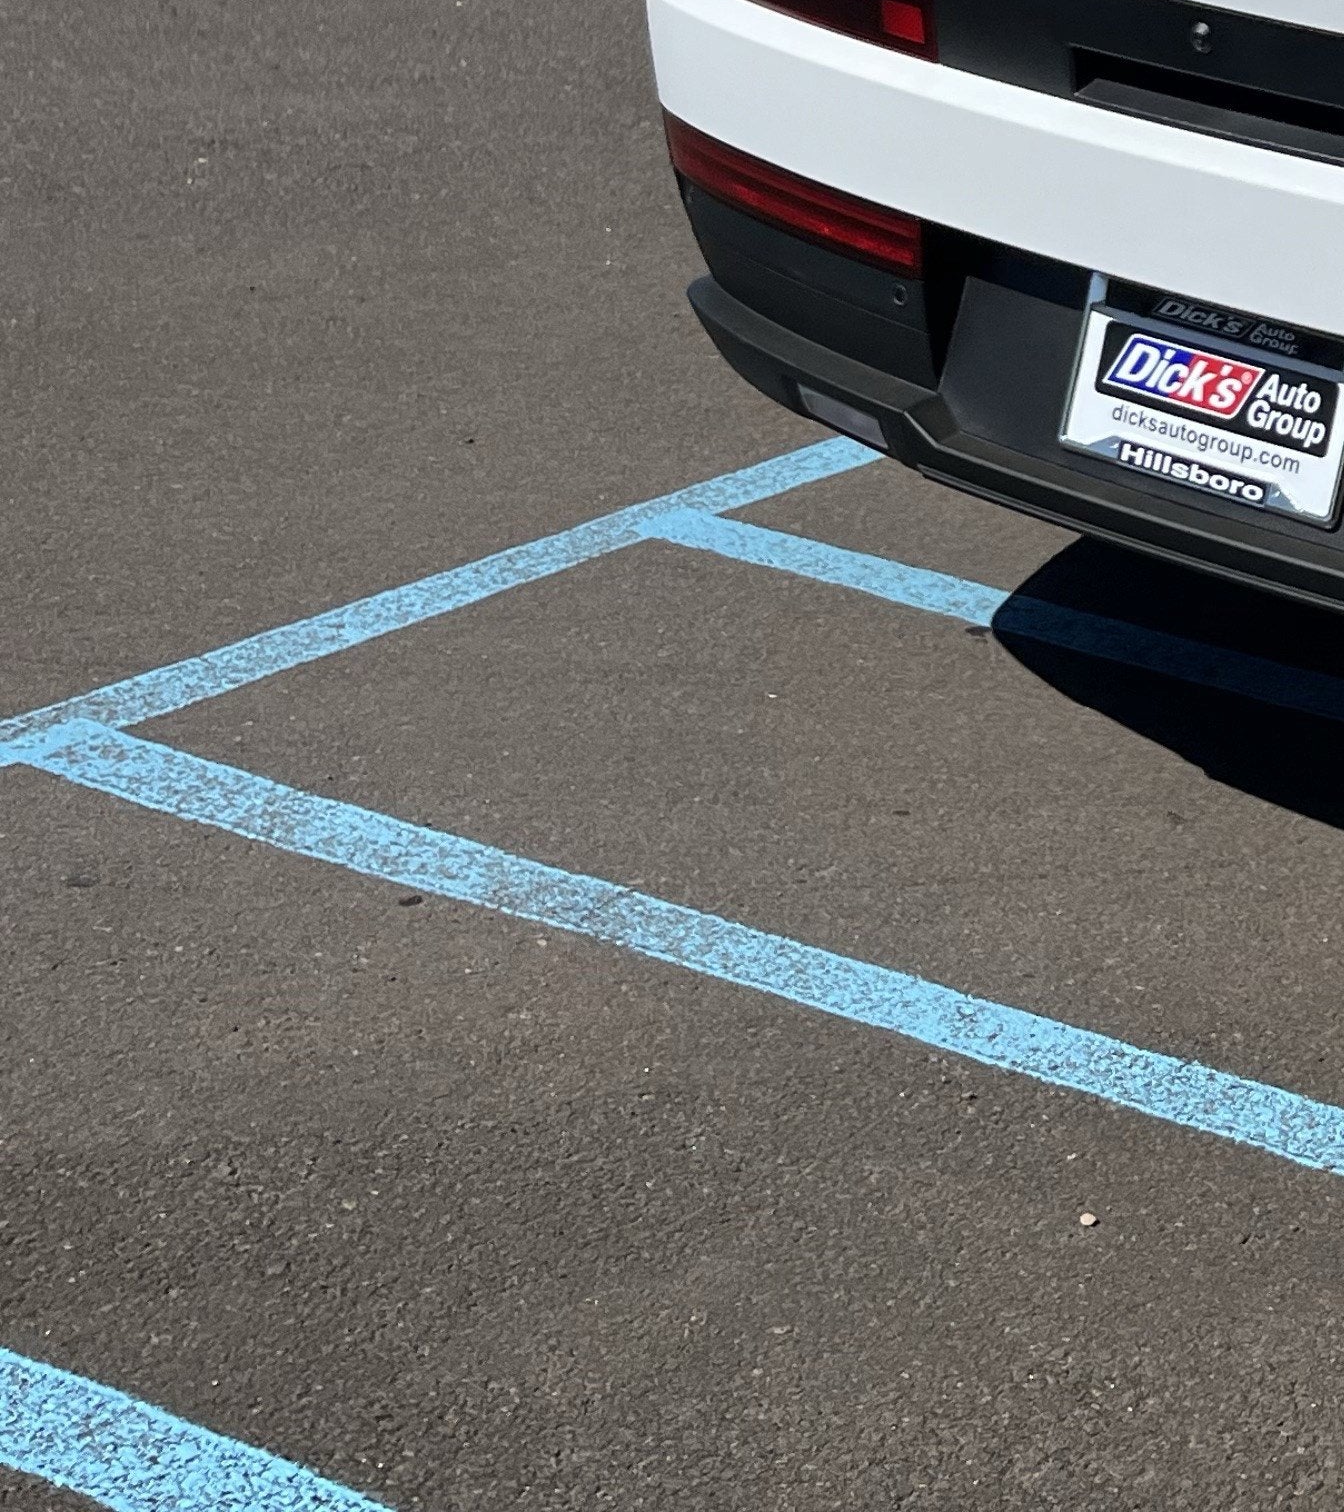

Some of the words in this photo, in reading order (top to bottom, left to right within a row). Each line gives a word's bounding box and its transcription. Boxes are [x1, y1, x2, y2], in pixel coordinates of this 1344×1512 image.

[1158, 299, 1243, 334] Dick's
[1253, 323, 1295, 341] Auto
[1255, 374, 1322, 414] Auto
[1111, 402, 1300, 475] dicksautogroup.com
[1247, 402, 1327, 448] Group
[1119, 441, 1264, 503] Hillsboro
